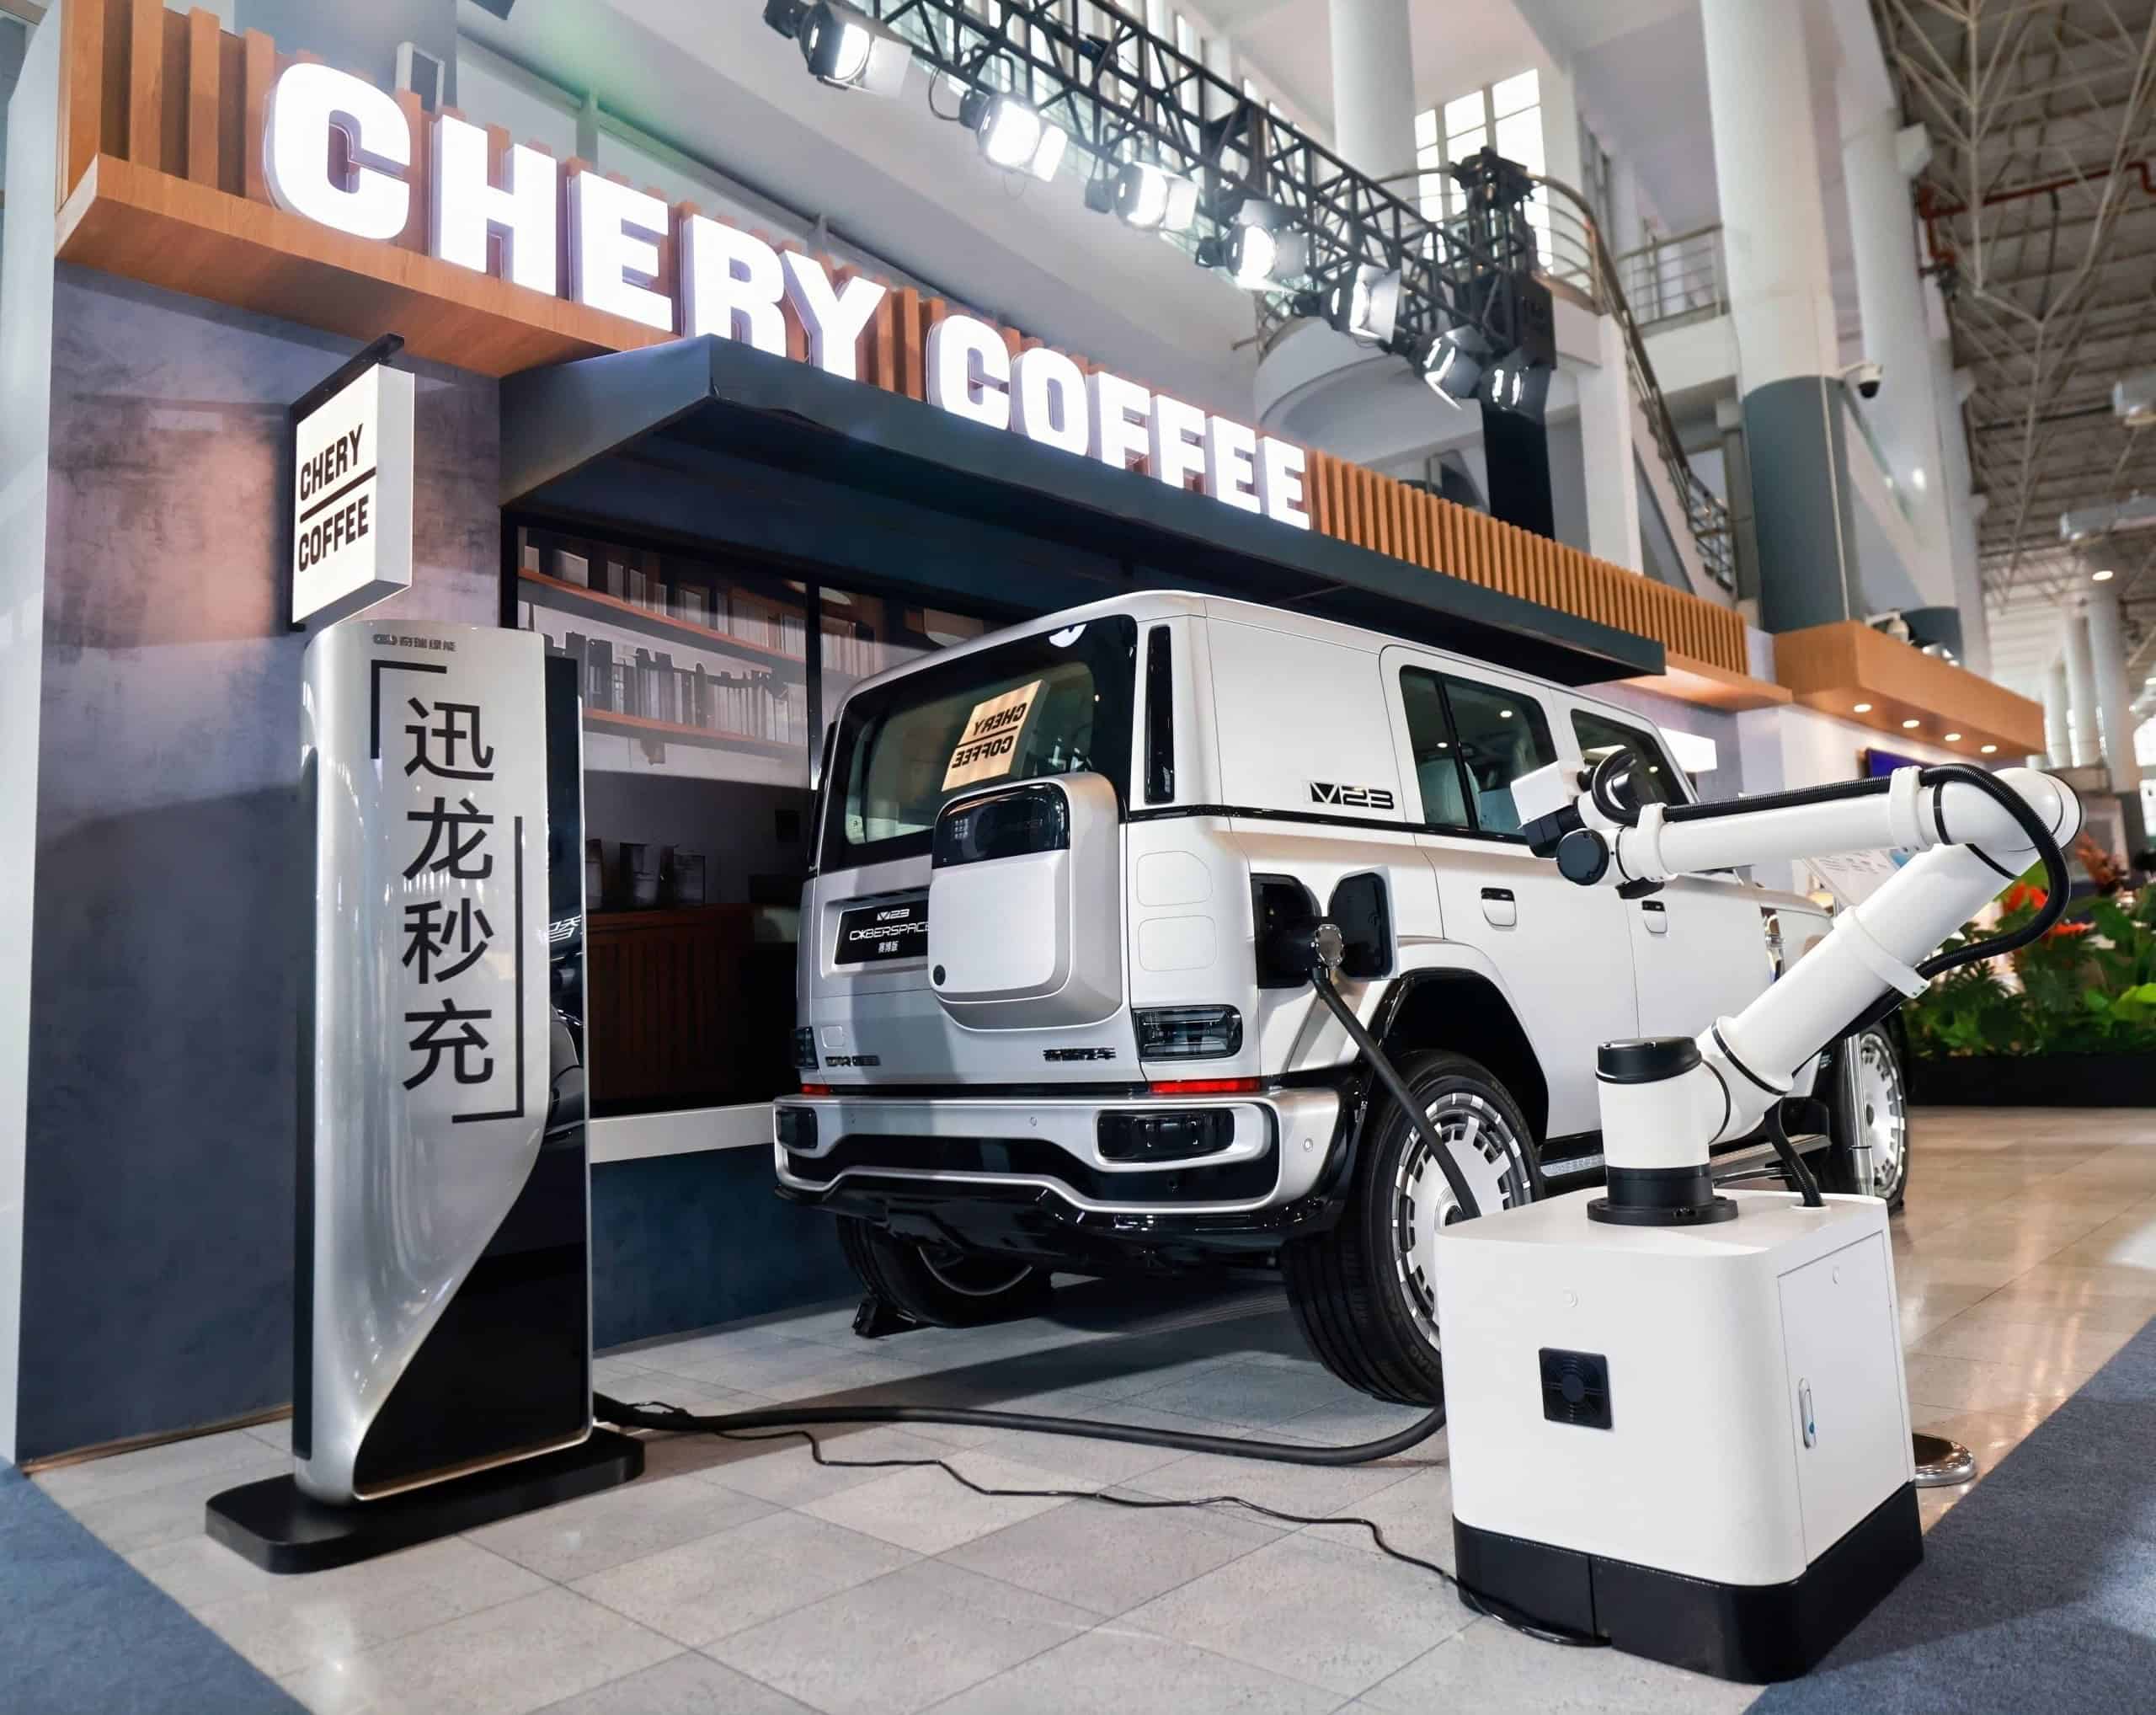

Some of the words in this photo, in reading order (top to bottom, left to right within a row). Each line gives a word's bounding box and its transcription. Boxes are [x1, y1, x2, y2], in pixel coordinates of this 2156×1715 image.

[266, 61, 886, 381] CHERY
[931, 315, 1310, 531] COFFEE
[298, 494, 369, 573] COFFEE
[300, 423, 364, 502] CHERY
[403, 697, 494, 1091] 迅龙秒充
